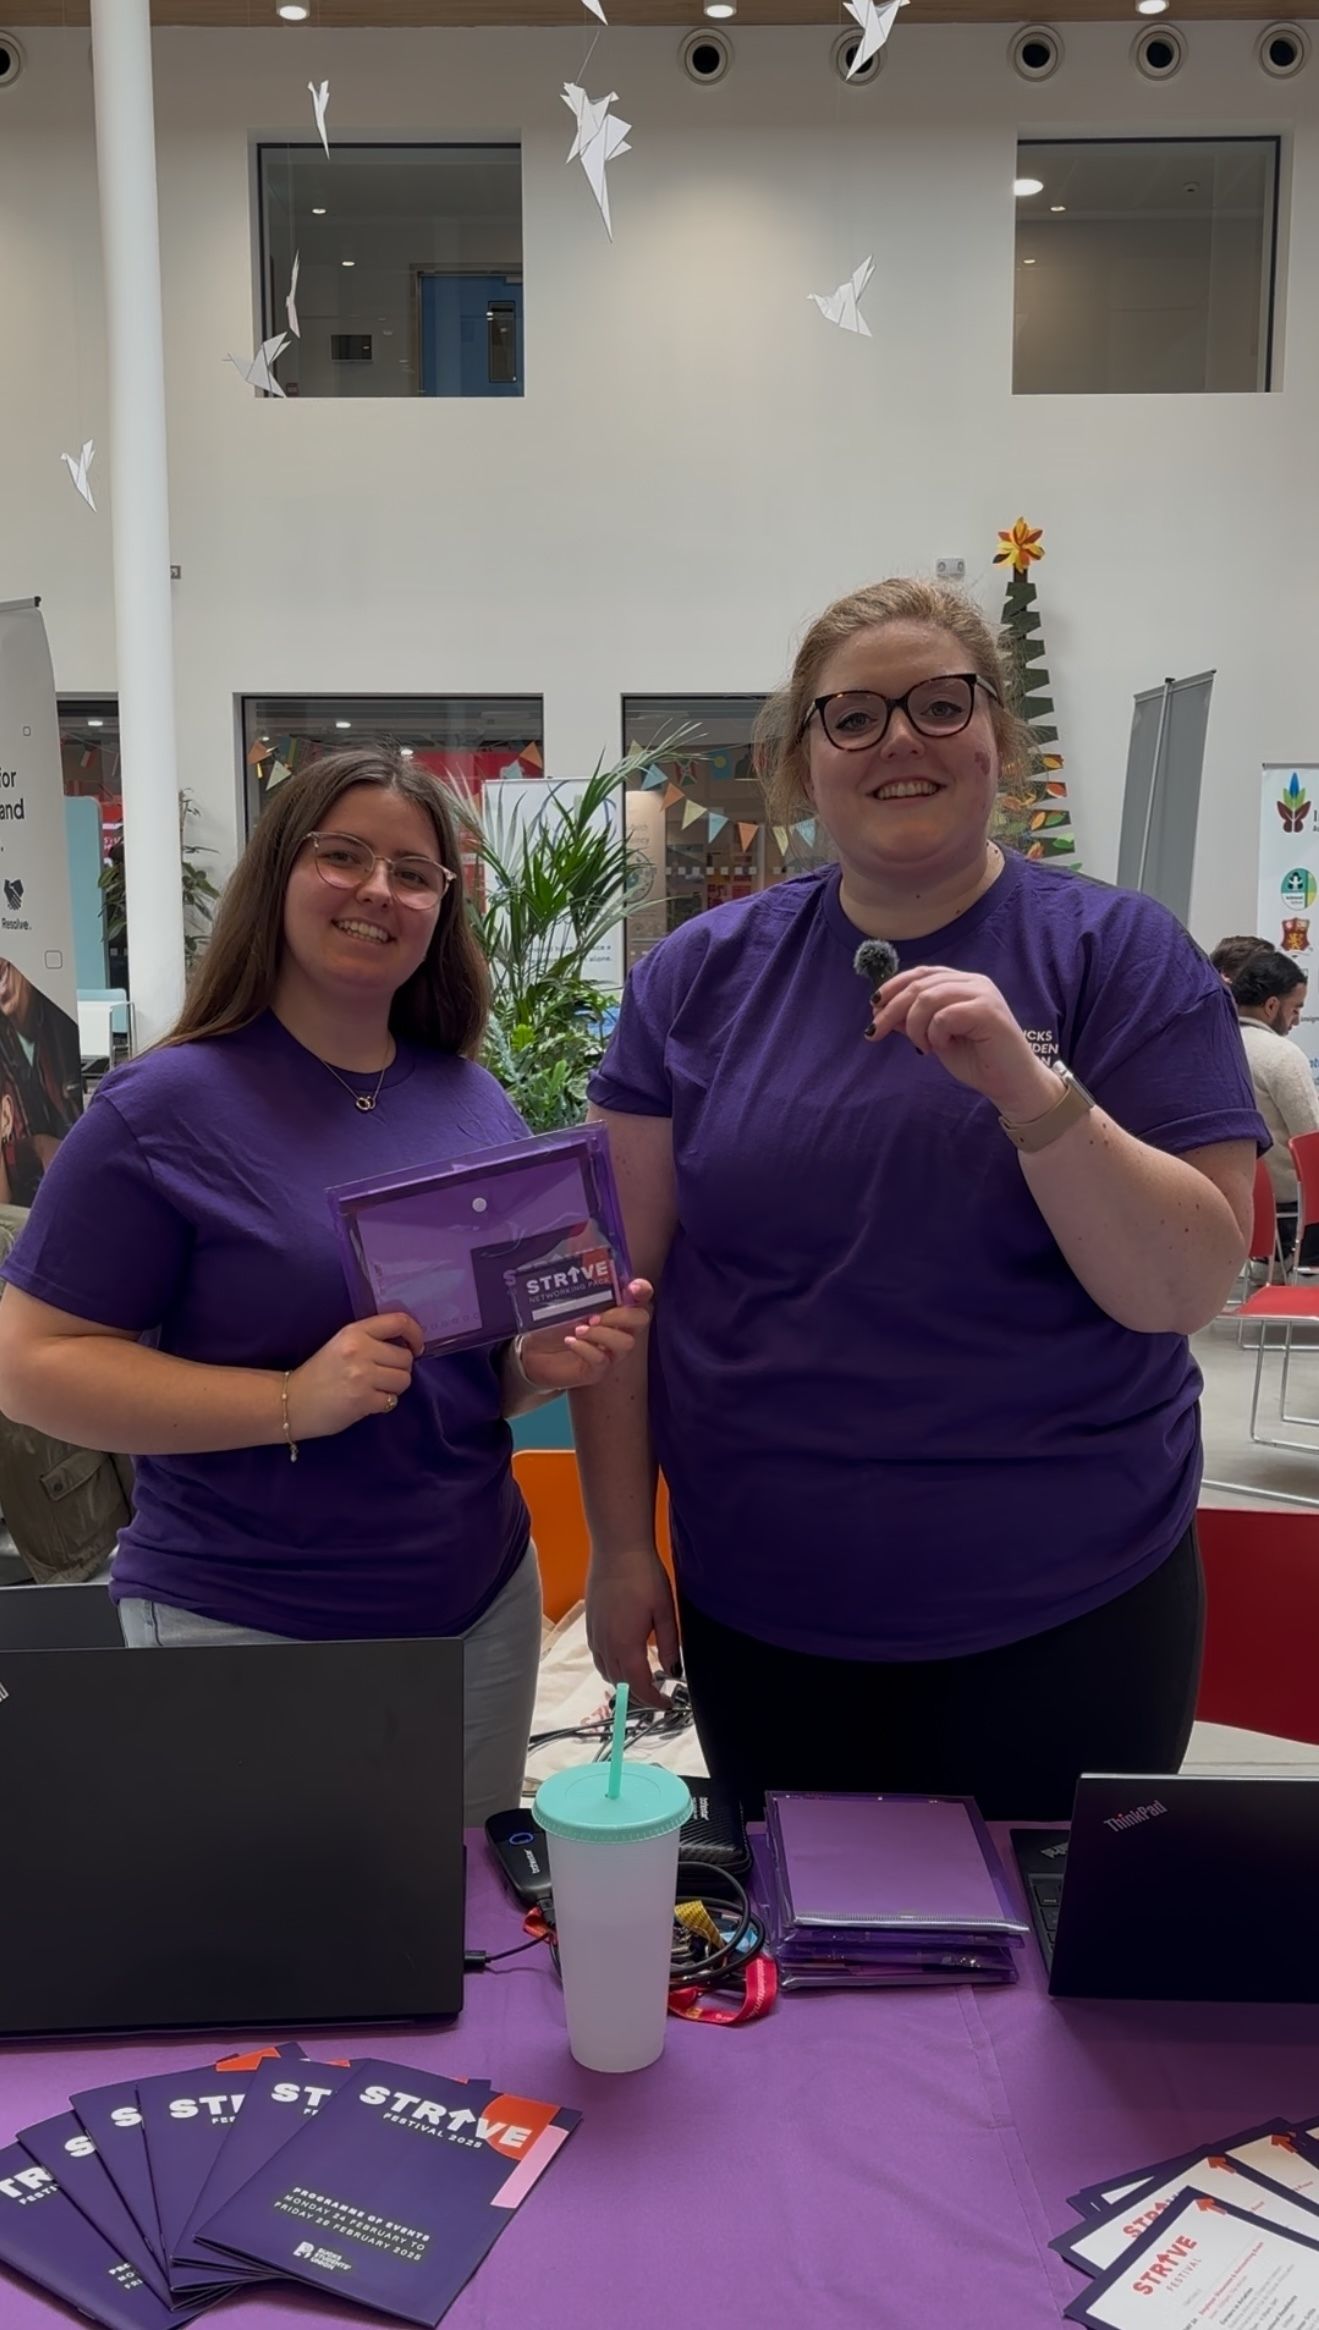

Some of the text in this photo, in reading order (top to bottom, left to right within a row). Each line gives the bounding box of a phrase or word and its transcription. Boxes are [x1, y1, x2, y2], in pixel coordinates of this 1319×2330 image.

[0, 798, 24, 820] and
[528, 1282, 587, 1303] NETWORKING
[1103, 1799, 1168, 1832] ThinkPad
[383, 2112, 483, 2149] FESTIVAL 2025
[19, 2184, 58, 2205] FESTI
[273, 2201, 314, 2221] FRIDAY
[332, 2223, 392, 2250] FEBRUARY
[392, 2246, 422, 2262] 2025
[283, 2194, 426, 2251] MONDAY 24 FEBRUARY TO
[292, 2187, 431, 2243] PROGRAMME OF EVENTS
[1166, 2258, 1202, 2292] FESTIVAL
